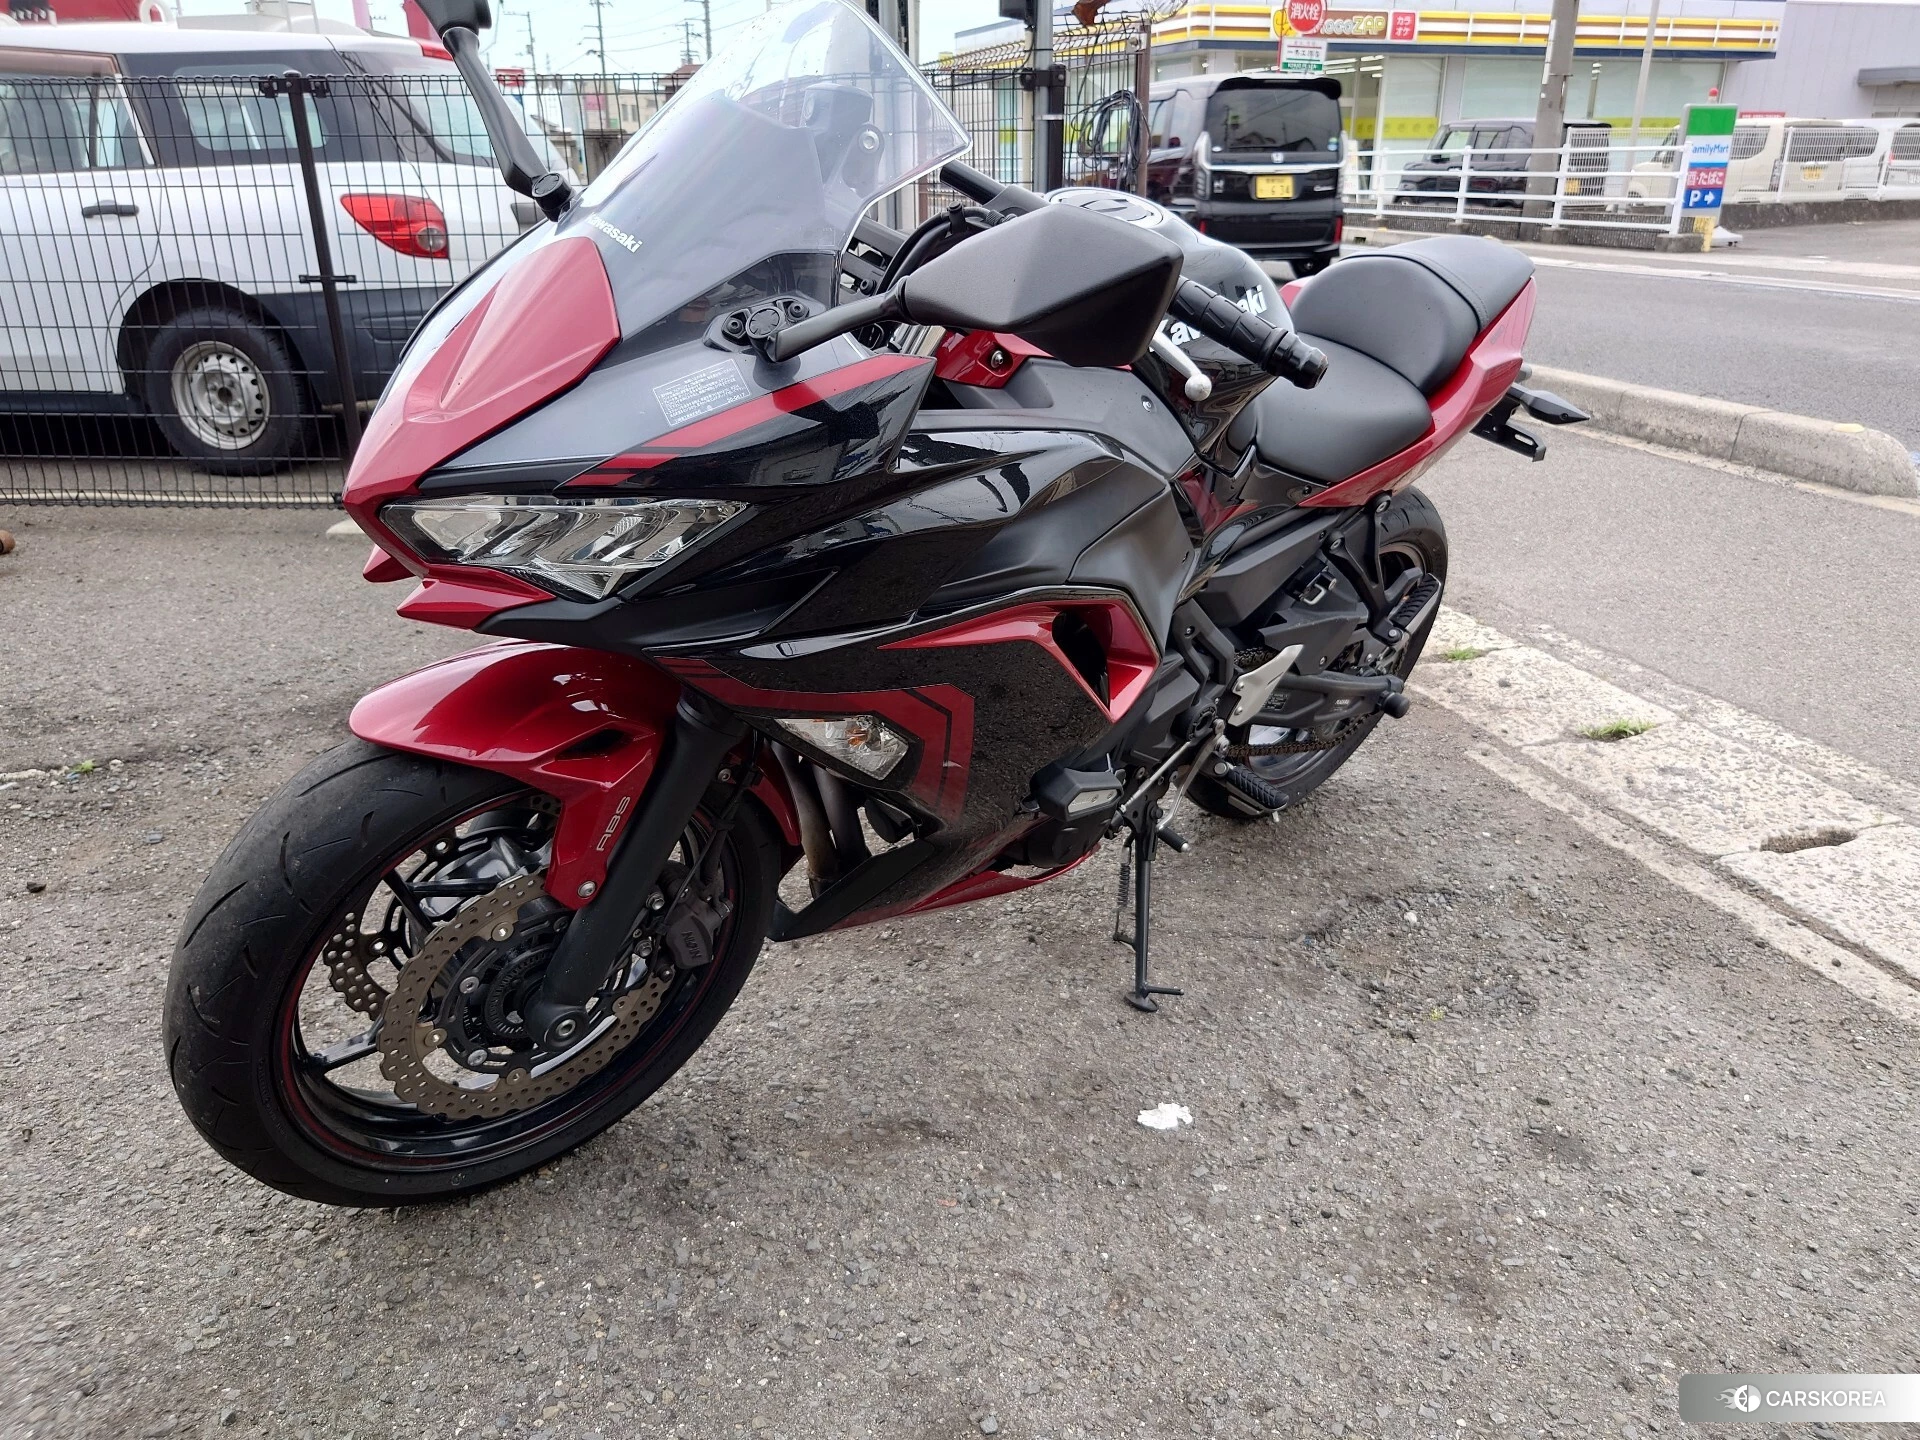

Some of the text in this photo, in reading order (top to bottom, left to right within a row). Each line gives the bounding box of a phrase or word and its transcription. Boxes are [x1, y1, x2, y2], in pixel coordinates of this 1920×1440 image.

[1290, 2, 1319, 21] 消火栓
[1396, 15, 1411, 25] カラ
[1320, 15, 1386, 35] ocoZAP
[1692, 143, 1729, 156] amilyMart
[1689, 190, 1701, 207] P
[597, 796, 631, 851] ABS
